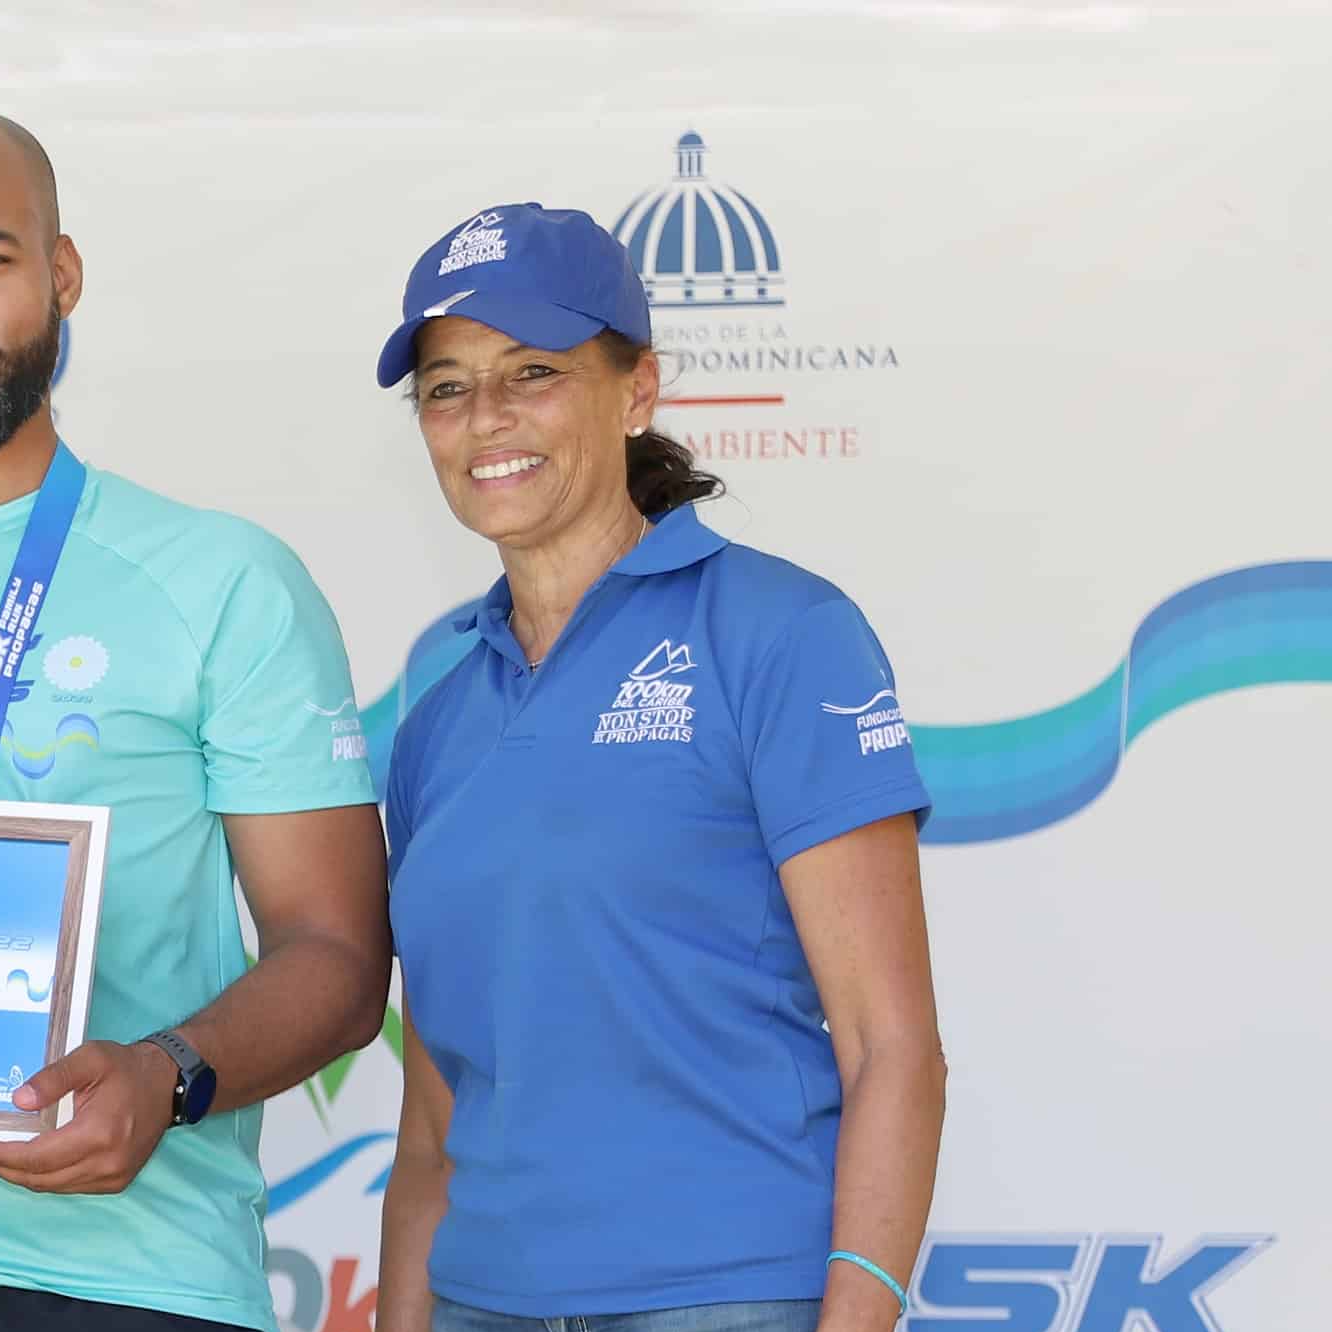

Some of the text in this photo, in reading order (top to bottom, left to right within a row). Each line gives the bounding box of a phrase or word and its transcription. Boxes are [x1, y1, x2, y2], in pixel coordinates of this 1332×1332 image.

[679, 346, 903, 374] DOMINICANA
[3, 581, 44, 678] PROPAGAS
[597, 708, 694, 731] NON STOP
[605, 727, 694, 744] PROPAGAS
